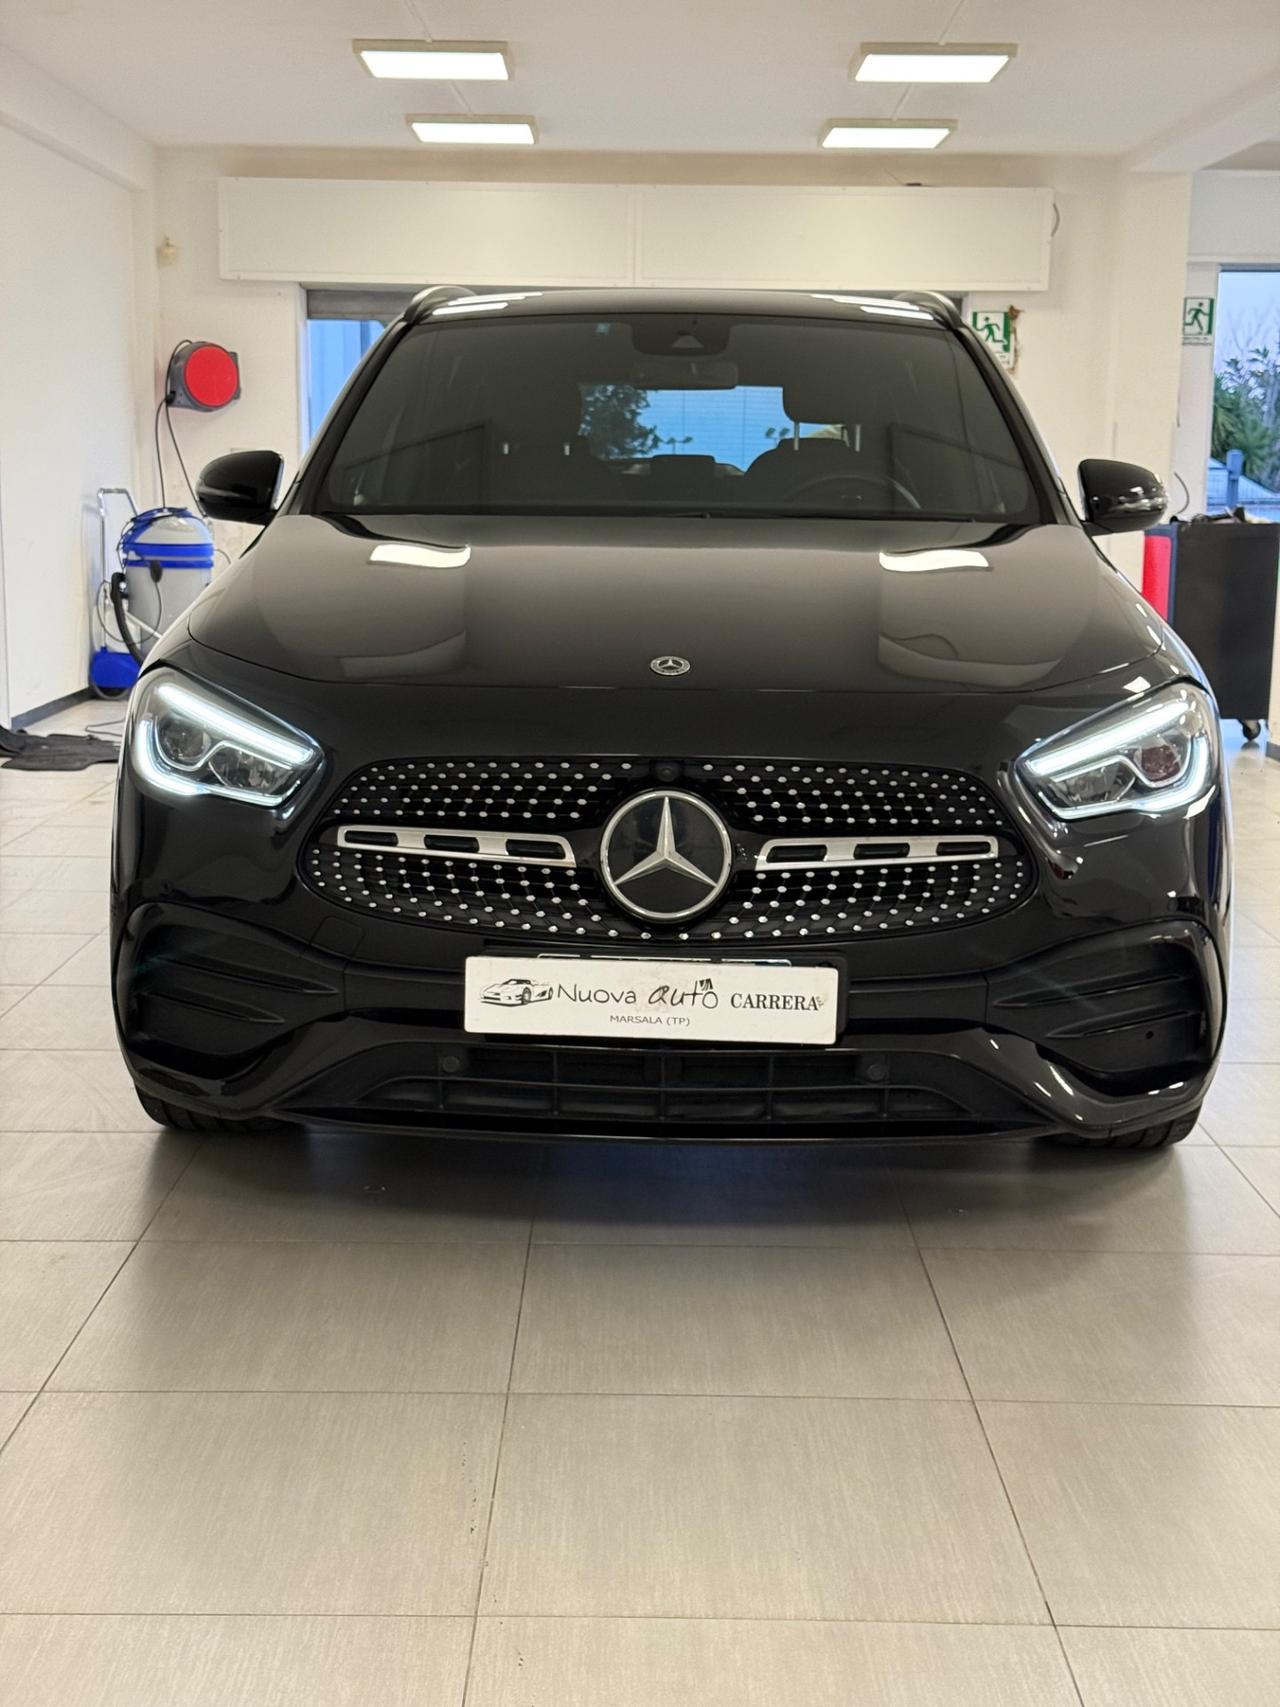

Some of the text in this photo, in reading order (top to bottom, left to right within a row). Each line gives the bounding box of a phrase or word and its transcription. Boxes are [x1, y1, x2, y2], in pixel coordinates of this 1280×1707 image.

[557, 983, 637, 1004] Nuova
[730, 992, 819, 1011] CARRERA
[609, 1015, 691, 1027] MARSALA (TP)
